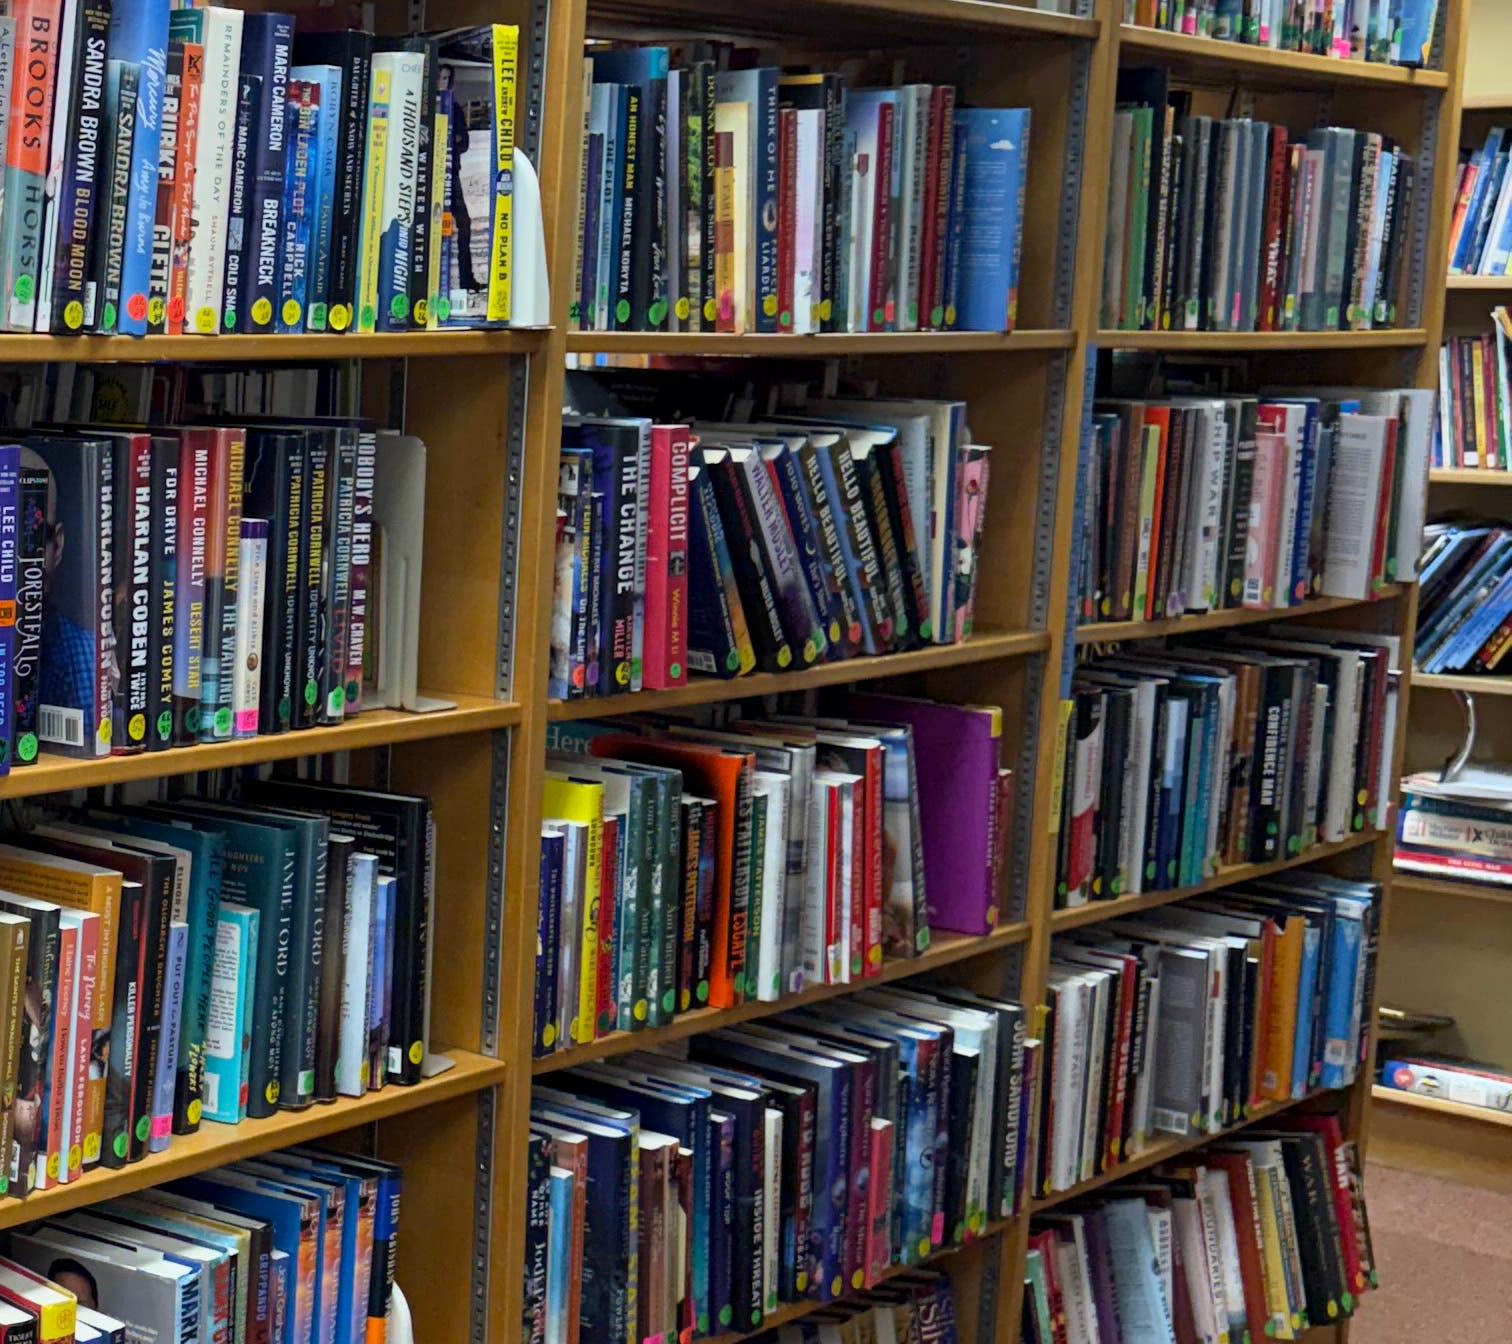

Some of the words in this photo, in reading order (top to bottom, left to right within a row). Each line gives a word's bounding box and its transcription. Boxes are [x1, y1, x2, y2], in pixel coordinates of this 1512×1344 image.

[23, 15, 50, 149] BROOKS
[82, 37, 106, 111] SANDRA
[274, 44, 288, 83] MARC
[501, 59, 514, 83] LEE
[269, 87, 284, 151] CAMERON
[630, 96, 637, 112] AN
[76, 115, 98, 183] BROWN
[500, 118, 513, 161] CHILD
[628, 116, 638, 161] HONEST
[626, 164, 635, 190] MAN
[72, 188, 89, 240] BLOOD
[258, 198, 278, 285] BREAKNECK
[69, 244, 85, 291] MOON
[355, 433, 376, 516] NOBODY'S
[622, 454, 638, 494] THE
[668, 440, 687, 542] COMPLICIT
[3, 506, 15, 534] LEE
[134, 485, 150, 584] HARLAN
[351, 522, 370, 565] HERO
[1, 539, 15, 583] CHILD
[616, 503, 636, 595] CHANGE
[132, 587, 148, 666] COBEN
